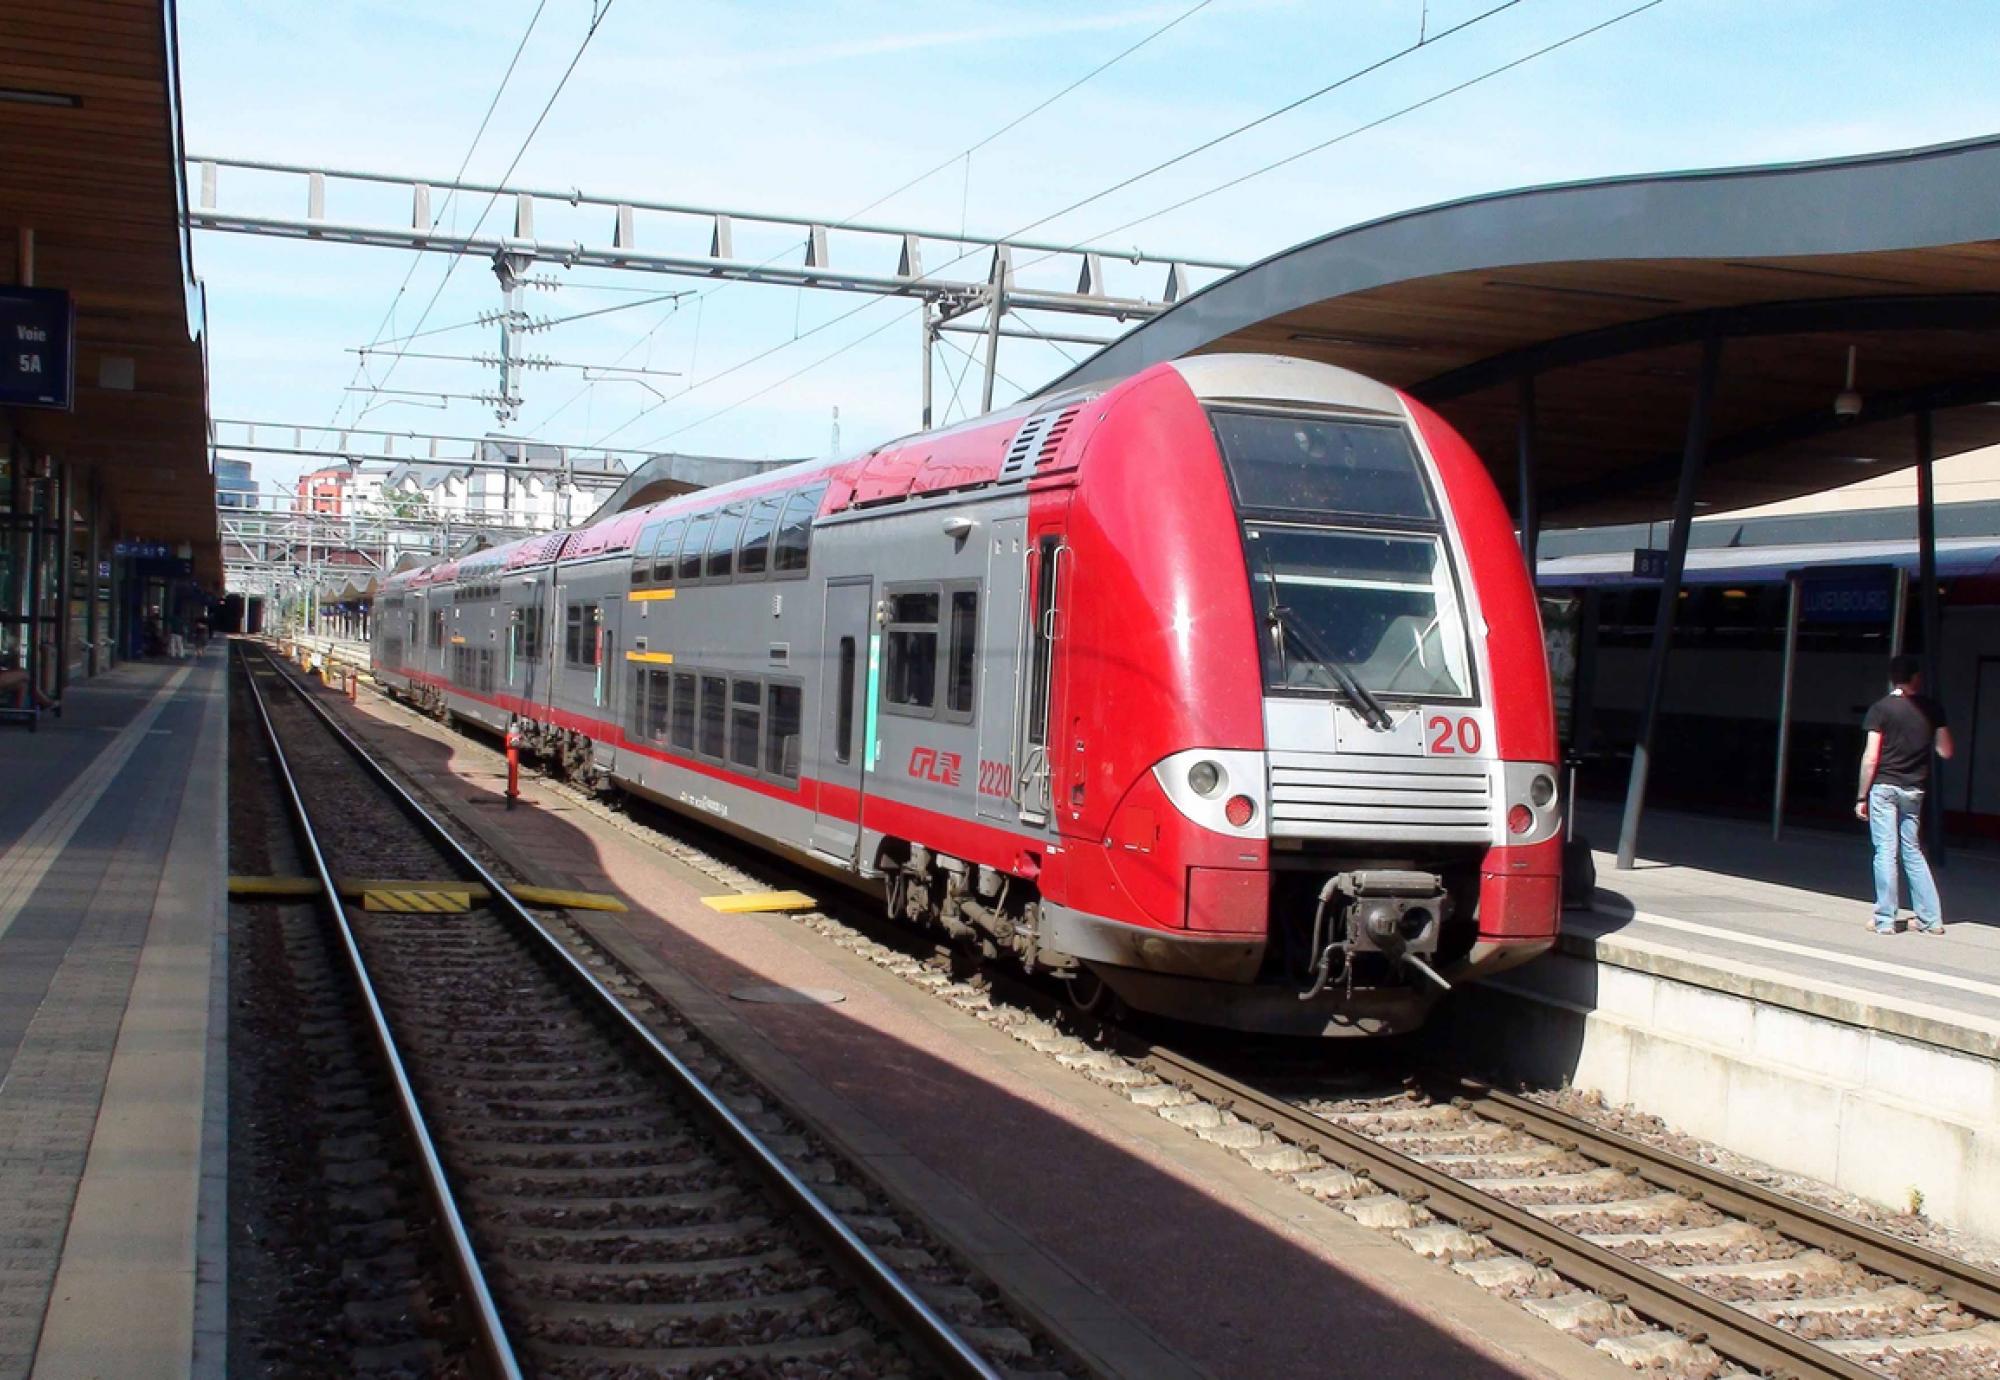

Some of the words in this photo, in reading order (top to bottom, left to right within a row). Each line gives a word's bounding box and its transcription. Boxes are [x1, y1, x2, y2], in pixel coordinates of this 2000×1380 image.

[17, 325, 46, 342] Voie
[19, 354, 42, 373] 5A
[1803, 590, 1889, 612] LUXEMBOURG
[1428, 715, 1482, 754] 20
[908, 746, 943, 783] CFL
[978, 759, 1012, 799] 2220
